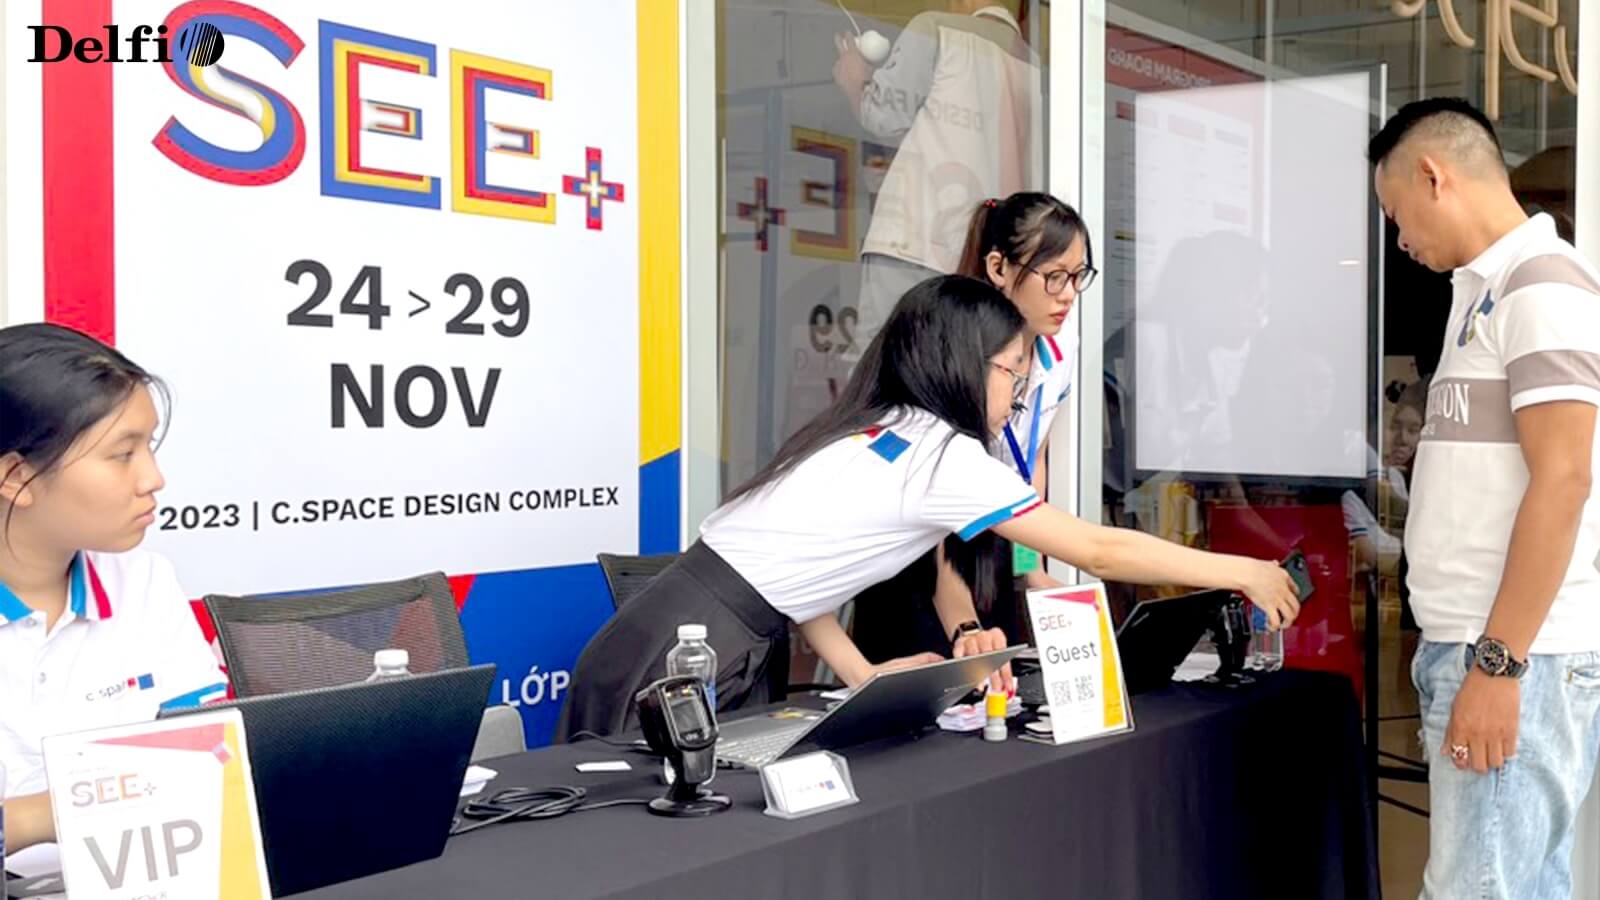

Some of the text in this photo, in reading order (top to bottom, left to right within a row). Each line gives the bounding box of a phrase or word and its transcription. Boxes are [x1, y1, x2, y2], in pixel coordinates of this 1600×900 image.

[285, 259, 391, 330] 24
[443, 272, 531, 337] 29
[330, 362, 501, 429] NOV
[159, 503, 240, 531] 2023
[271, 497, 395, 524] C.SPACE
[404, 492, 500, 517] DESIGN
[509, 486, 619, 511] COMPLEX
[1046, 641, 1098, 664] Guest
[501, 665, 570, 707] LỚP
[71, 773, 157, 808] SEE+
[83, 818, 204, 891] VIP
